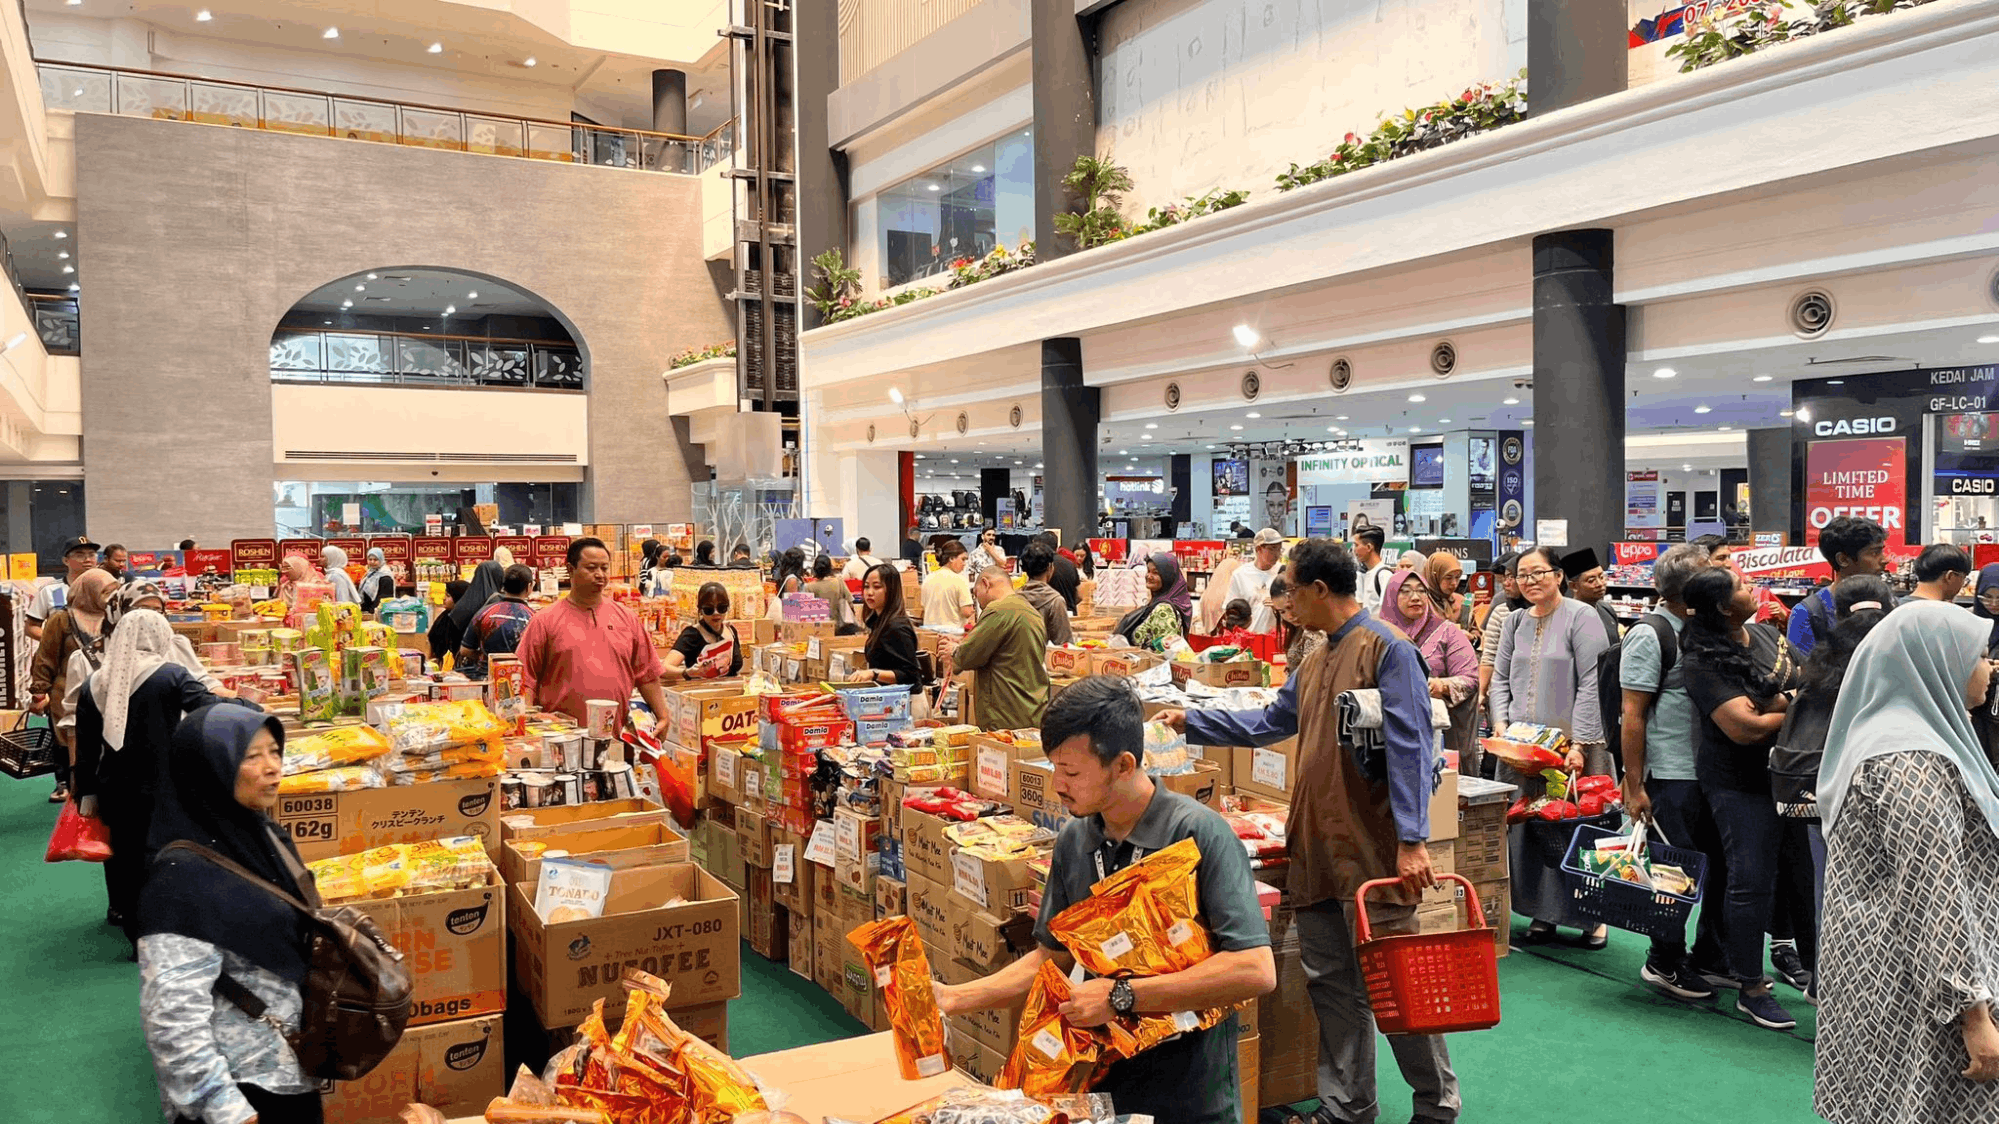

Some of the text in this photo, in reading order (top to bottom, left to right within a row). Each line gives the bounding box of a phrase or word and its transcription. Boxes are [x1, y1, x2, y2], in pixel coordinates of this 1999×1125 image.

[1930, 368, 1995, 385] KEDAI JAM
[1930, 396, 1987, 411] GF-LC-01
[1815, 417, 1896, 436] CASIO
[1301, 457, 1348, 471] INFINITY
[1823, 470, 1889, 485] LIMITED
[1120, 481, 1151, 492] hotlink
[1834, 485, 1875, 499] TIME
[1952, 479, 1995, 493] CASIO
[238, 548, 271, 556] ROSHEN
[460, 545, 487, 553] ROSHEN
[1737, 546, 1814, 569] Biscolata
[860, 695, 884, 703] Damia
[804, 726, 828, 735] Damia
[866, 722, 888, 730] Damia
[1022, 774, 1042, 786] 60013
[462, 797, 486, 808] tenten
[1021, 788, 1043, 806] 360g
[284, 798, 333, 813] 60038
[391, 809, 426, 819] テンテン
[284, 820, 333, 838] 162g
[371, 815, 446, 829] クリスピークランチ
[450, 911, 480, 925] tenten
[653, 919, 722, 941] JXT-080
[450, 1044, 480, 1061] tenten
